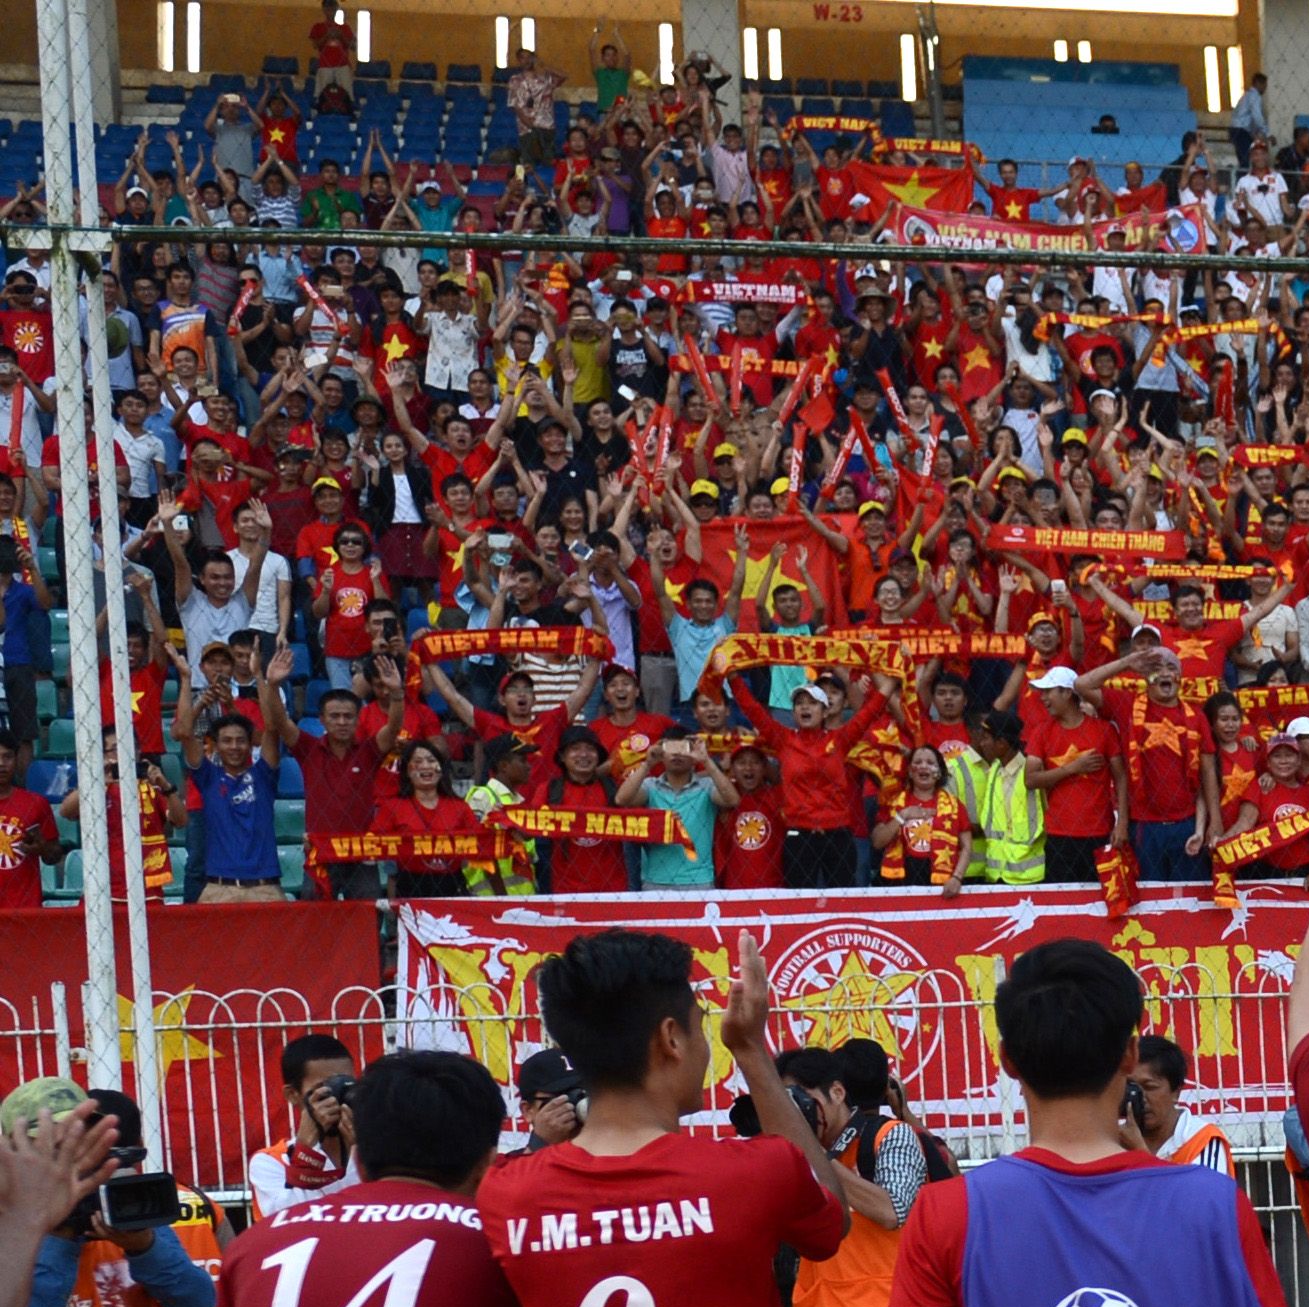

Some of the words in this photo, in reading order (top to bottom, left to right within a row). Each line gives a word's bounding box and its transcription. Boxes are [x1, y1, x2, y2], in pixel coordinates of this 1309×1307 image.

[813, 4, 863, 22] W-23
[713, 283, 796, 298] VIETNAM
[499, 630, 560, 649] NAM
[971, 635, 1027, 655] NAM
[506, 804, 576, 836] VIỆT
[586, 813, 649, 838] NAM
[331, 831, 402, 860] VIỆT
[413, 835, 478, 856] NAM
[1217, 825, 1272, 866] VIỆT
[776, 940, 824, 996] FOOTBALL
[825, 932, 913, 969] SUPPORTERS
[271, 1202, 483, 1231] L.X.TRUONG
[507, 1197, 714, 1256] V.M.TUAN
